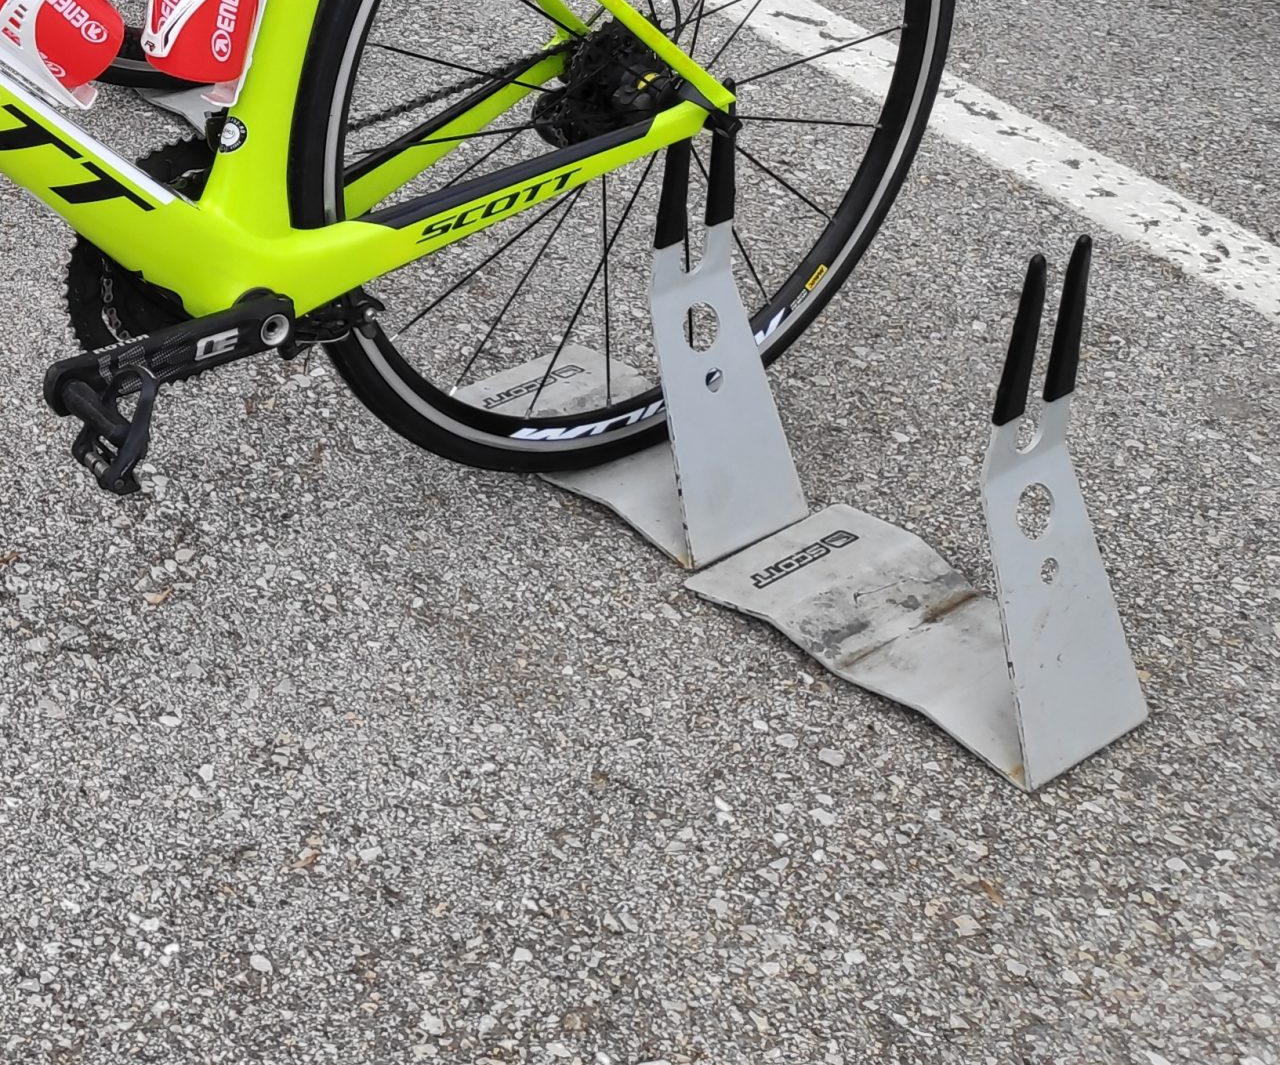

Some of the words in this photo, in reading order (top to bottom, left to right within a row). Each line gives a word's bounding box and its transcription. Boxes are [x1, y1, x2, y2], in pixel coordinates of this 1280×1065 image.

[416, 167, 584, 244] SCOTT
[92, 334, 150, 355] ROTOR
[750, 542, 831, 589] SCOTT
